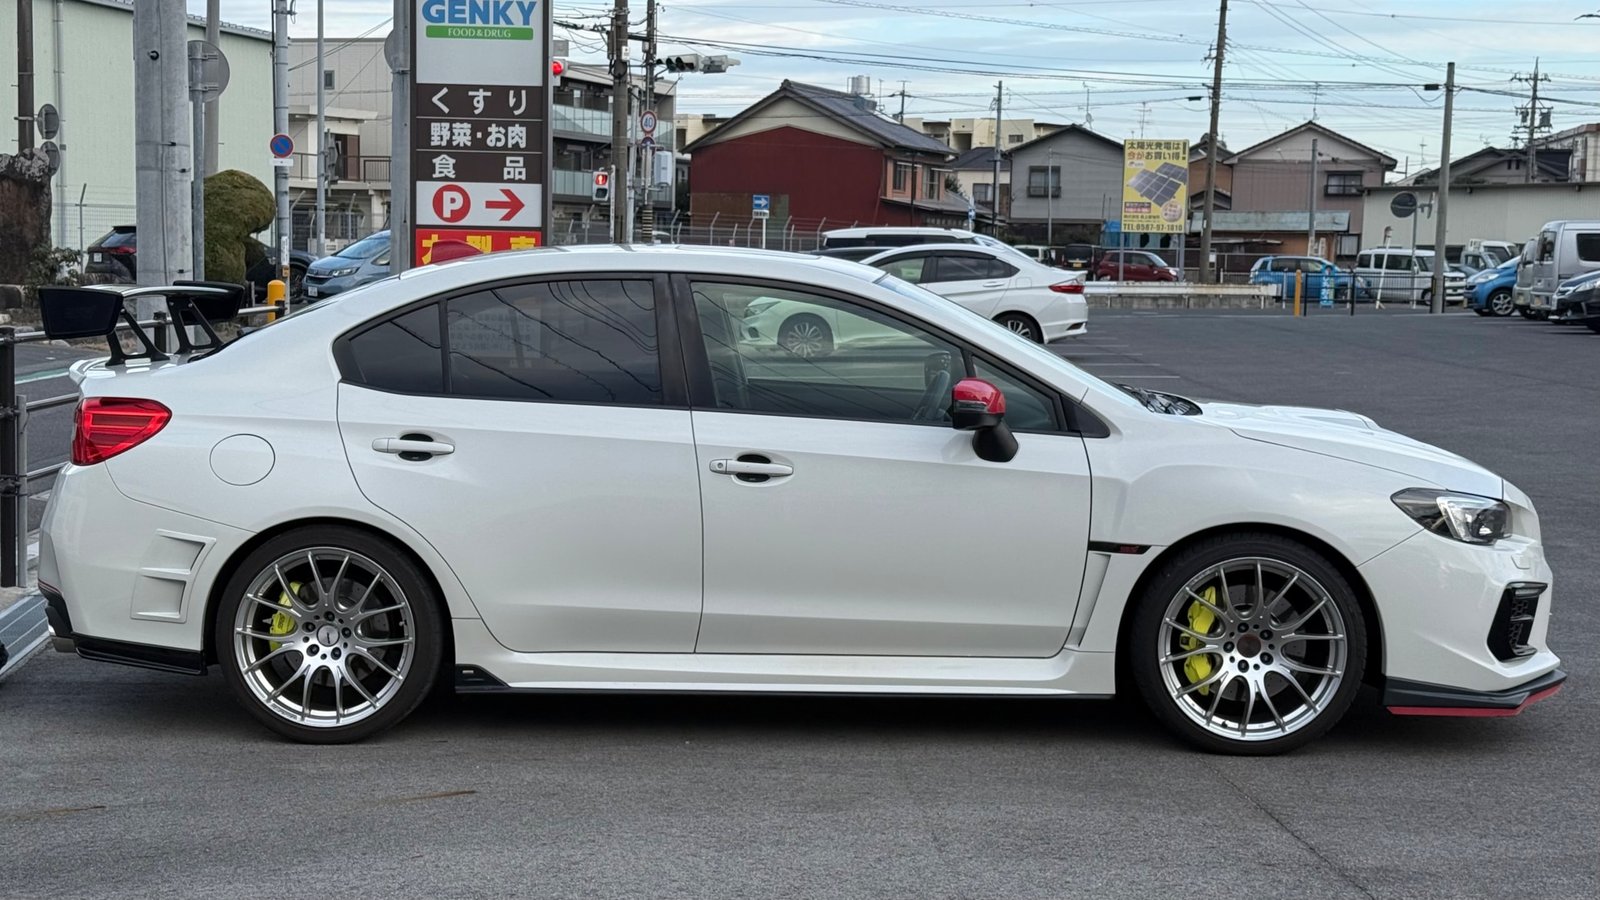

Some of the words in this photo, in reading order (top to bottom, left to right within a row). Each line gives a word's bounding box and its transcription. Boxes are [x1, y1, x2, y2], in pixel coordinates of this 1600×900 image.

[422, 0, 537, 25] GENKY
[431, 87, 527, 115] くすり
[644, 116, 653, 128] 40
[443, 190, 464, 218] P
